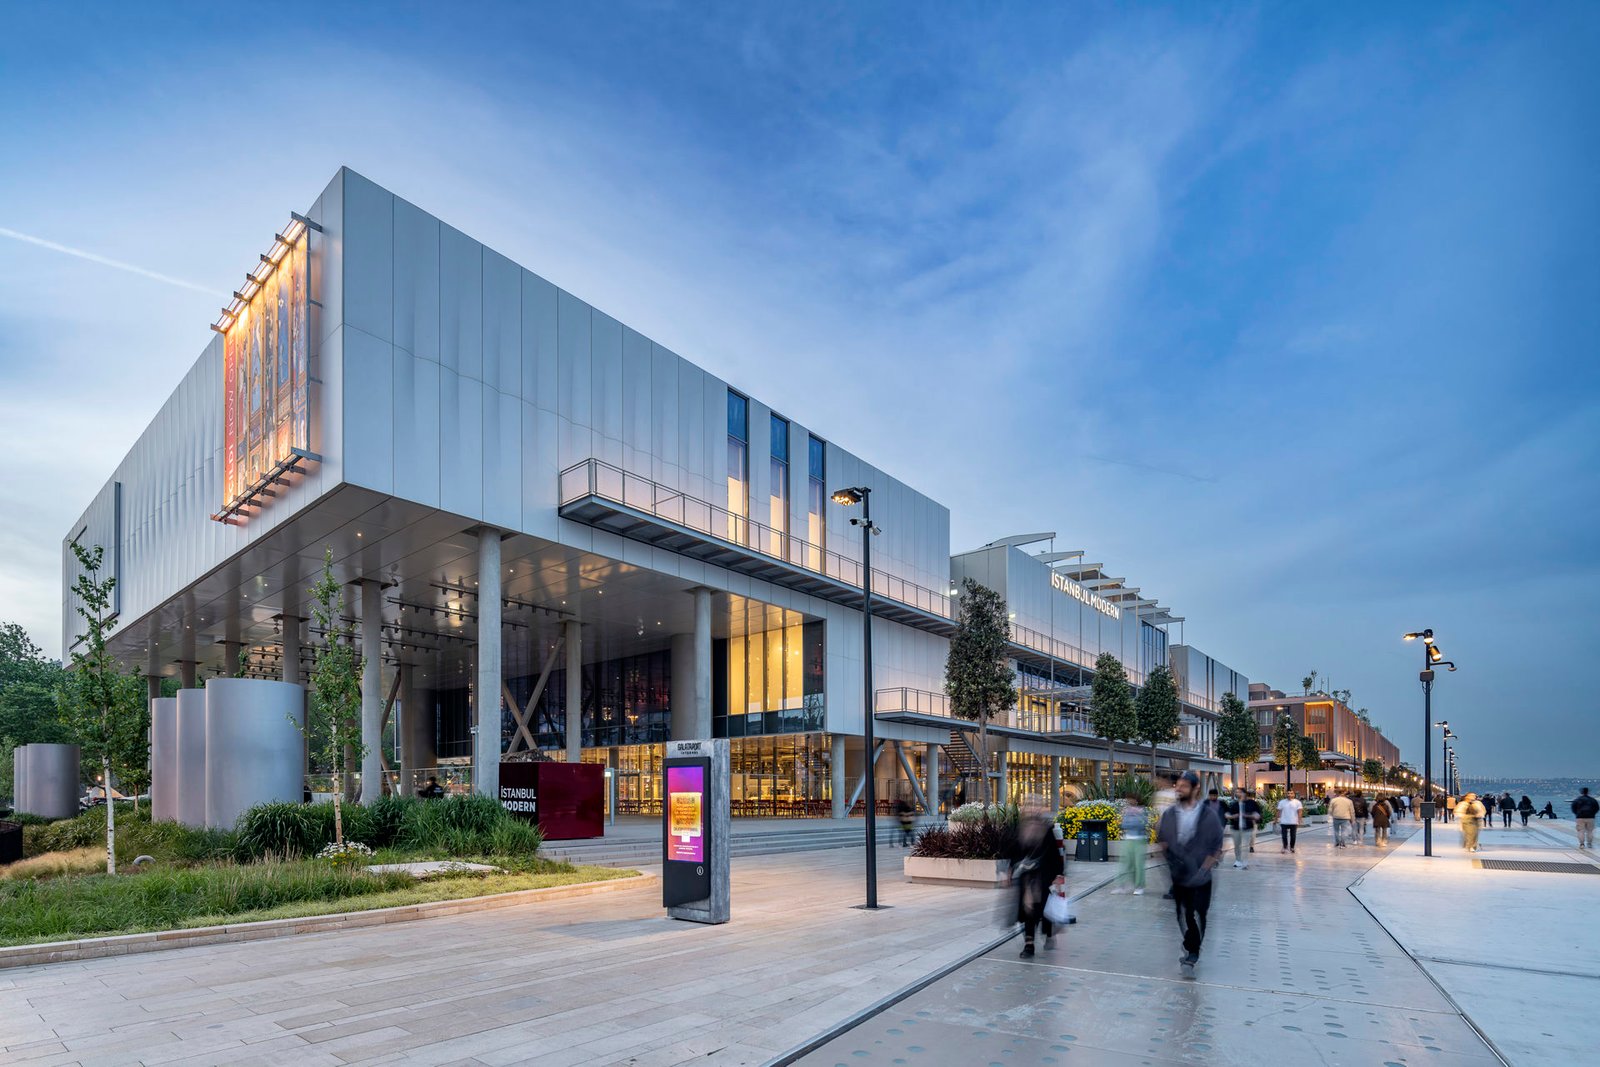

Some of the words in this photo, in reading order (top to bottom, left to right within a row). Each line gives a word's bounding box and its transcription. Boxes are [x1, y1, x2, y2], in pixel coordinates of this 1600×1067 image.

[1051, 569, 1090, 605] İSTANBUL
[1090, 593, 1120, 620] MODERN
[500, 785, 537, 799] İSTANBUL
[501, 800, 536, 812] MODERN
